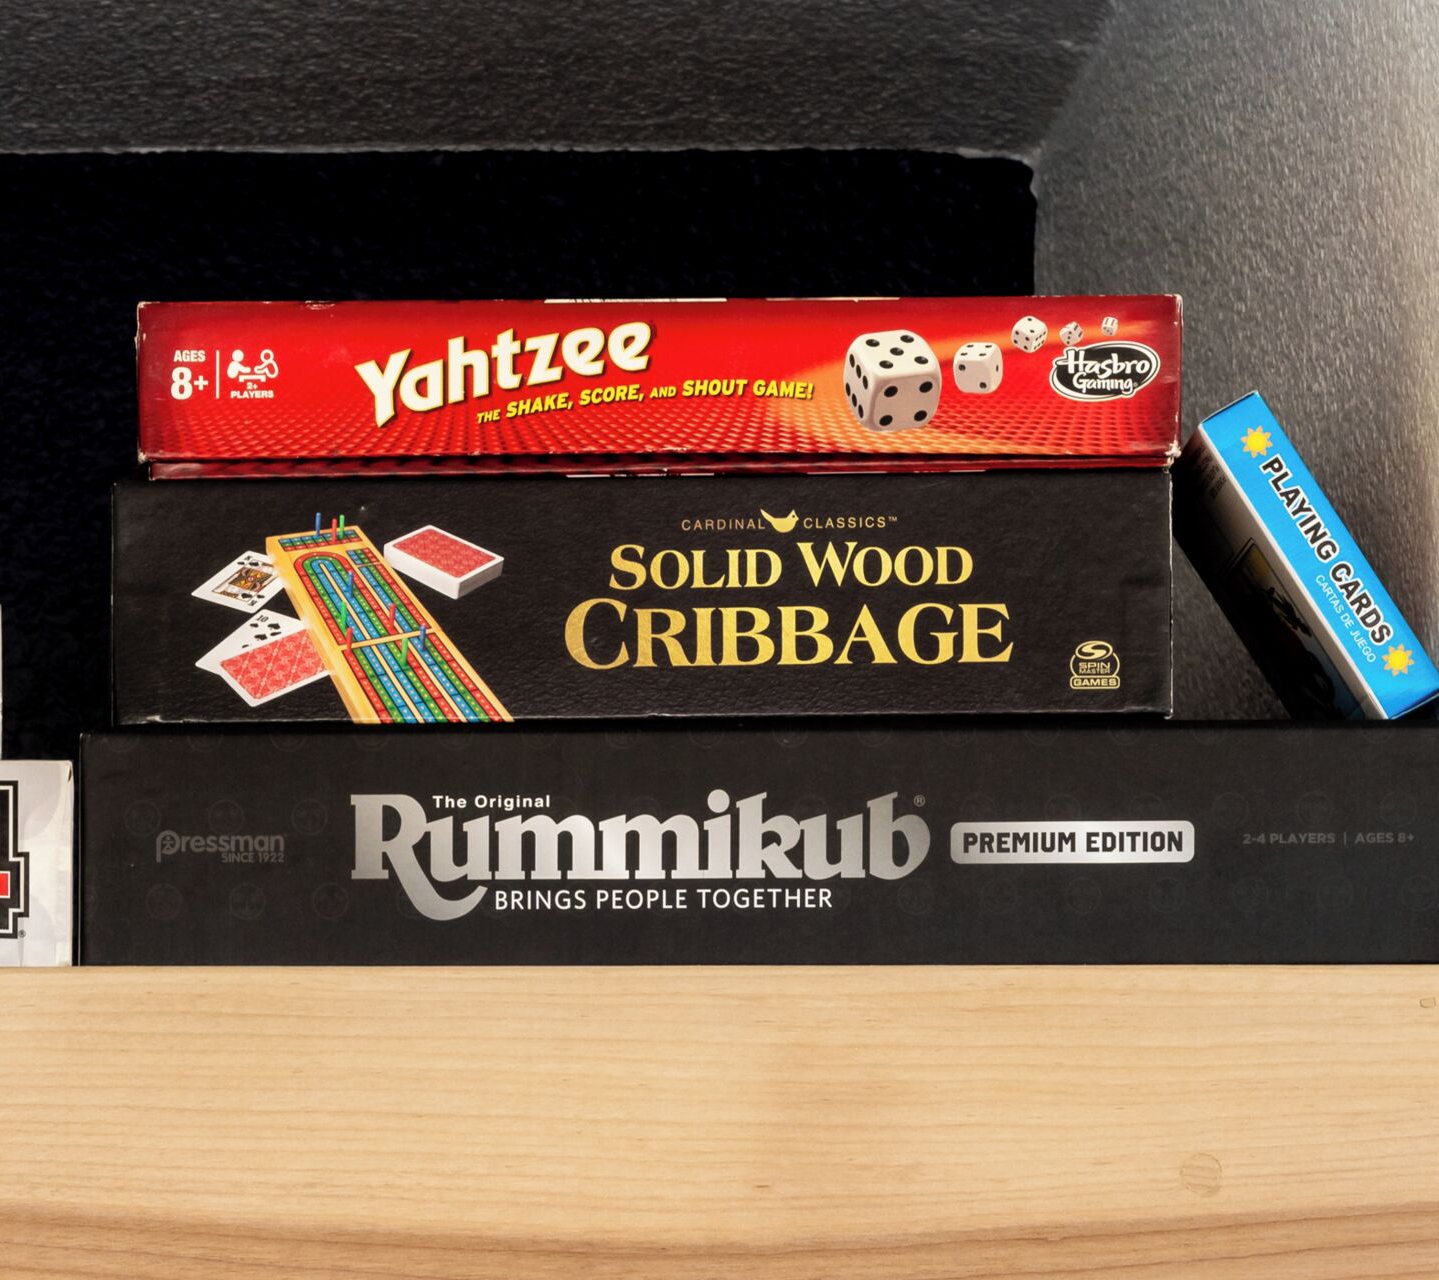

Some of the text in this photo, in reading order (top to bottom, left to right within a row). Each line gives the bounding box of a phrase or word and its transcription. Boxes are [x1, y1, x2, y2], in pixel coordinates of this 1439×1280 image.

[355, 322, 651, 428] Yahtzee
[1060, 349, 1151, 377] Hasbro
[1073, 374, 1134, 393] Gaming
[477, 380, 813, 423] THE SHAKE, SCORE, AND SHOUT GAME!
[681, 518, 765, 532] CARDINAL
[1261, 456, 1393, 644] PLAYING CARDS
[565, 599, 1013, 669] CRIBBAGE
[1316, 575, 1376, 662] CARTAS DE JUEGO
[351, 789, 930, 921] Rummikub
[963, 831, 1183, 853] PREMIUM EDITION
[496, 888, 833, 909] BRINGS PEOPLE TOGETHER
